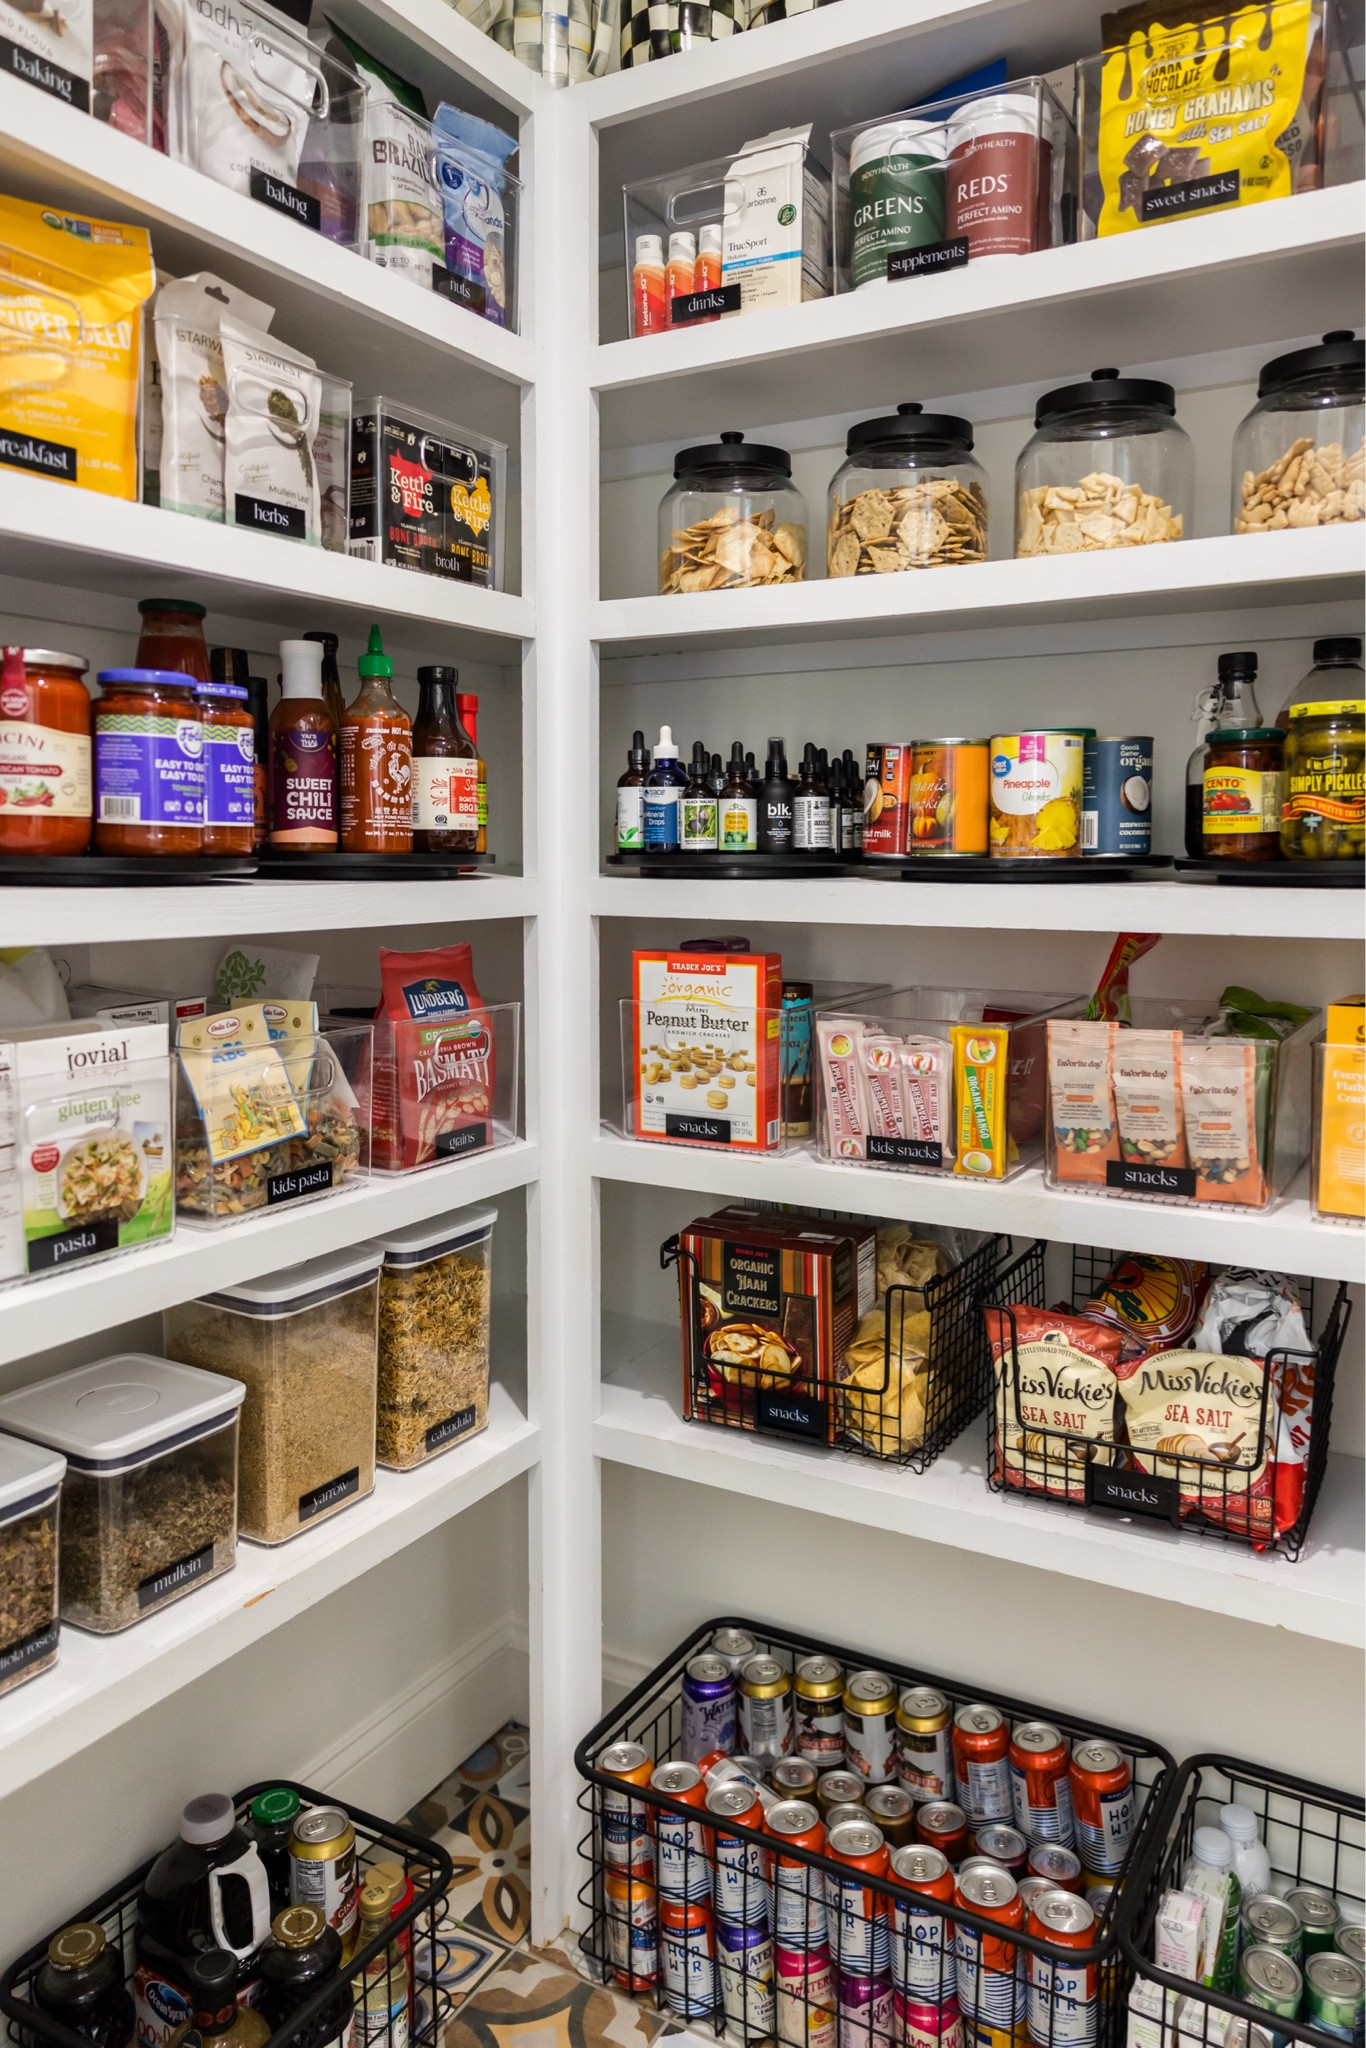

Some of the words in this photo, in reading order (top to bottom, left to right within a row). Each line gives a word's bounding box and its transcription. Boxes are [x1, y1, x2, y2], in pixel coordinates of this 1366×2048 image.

[12, 47, 72, 103] baking
[1125, 102, 1181, 138] HONEY
[1184, 78, 1275, 122] GRAHAMS
[1177, 121, 1207, 143] with
[1209, 125, 1233, 144] SEA
[1237, 113, 1270, 136] SALT
[957, 174, 1008, 203] REDS
[1145, 191, 1186, 212] sweet
[1188, 180, 1237, 201] snacks
[264, 178, 308, 220] baking
[747, 196, 777, 208] arbonne
[854, 195, 924, 228] GREENS
[956, 207, 990, 224] PERFECT
[990, 204, 1022, 215] AMINO
[881, 226, 911, 237] AMINO
[727, 238, 768, 252] TrueSport
[891, 245, 966, 272] supplements
[449, 278, 472, 299] nuts
[640, 278, 649, 326] Ketone-IQ
[687, 293, 725, 312] drinks
[0, 437, 69, 470] reakfast
[390, 466, 433, 496] Kettle
[268, 485, 297, 502] Mullein
[391, 487, 401, 504] &
[403, 491, 434, 514] Fire
[453, 486, 490, 515] Kettle
[253, 503, 290, 528] herbs
[453, 504, 463, 523] &
[464, 508, 490, 532] Fire
[389, 525, 410, 545] BONE
[435, 552, 460, 572] broth
[451, 543, 470, 558] BONE
[471, 549, 493, 567] BROTH
[391, 726, 402, 736] HOT
[155, 759, 181, 769] EASY
[184, 761, 195, 770] TO
[220, 764, 240, 773] EASY
[160, 770, 185, 781] EASY
[187, 771, 198, 781] TO
[225, 774, 245, 783] EASY
[286, 777, 333, 791] SWEET
[1003, 779, 1051, 790] Pineapple
[1207, 779, 1240, 789] CENTO
[1290, 774, 1323, 793] SIMPLY
[1325, 773, 1366, 792] PICKLES
[286, 791, 332, 807] CHILI
[649, 788, 666, 796] trace
[287, 808, 333, 821] SAUCE
[459, 803, 474, 812] BBQ
[767, 803, 792, 816] blk.
[873, 829, 892, 839] milk
[672, 962, 700, 971] TRADER
[701, 963, 724, 972] JOE'S
[667, 981, 734, 1000] organic
[409, 988, 465, 1016] LUNDBERG
[685, 1003, 709, 1014] MINI
[647, 1010, 698, 1030] Peanut
[700, 1014, 749, 1032] Butter
[699, 1031, 731, 1039] CRACKERS
[454, 1040, 477, 1051] BROWN
[67, 1040, 129, 1080] jovial
[1057, 1058, 1087, 1068] favorite
[1088, 1059, 1103, 1070] day
[890, 1076, 898, 1088] BAR
[1120, 1069, 1151, 1078] favorite
[1152, 1070, 1168, 1080] day
[968, 1075, 982, 1110] ORGANIC
[1063, 1082, 1095, 1090] monster
[1190, 1085, 1221, 1095] favorite
[1222, 1086, 1239, 1097] day
[1128, 1093, 1160, 1101] monster
[58, 1097, 108, 1123] gluten
[839, 1087, 862, 1136] STRAWBERRY
[963, 1104, 971, 1129] FRUIT
[1198, 1110, 1233, 1118] monster
[679, 1120, 718, 1136] snacks
[976, 1111, 990, 1140] MANGO
[448, 1131, 475, 1151] grains
[962, 1132, 970, 1145] BAR
[870, 1140, 895, 1156] kids
[897, 1144, 940, 1160] snacks
[271, 1174, 297, 1197] kids
[297, 1168, 330, 1193] pasta
[1124, 1169, 1179, 1187] snacks
[53, 1230, 96, 1261] pasta
[729, 1258, 774, 1275] ORGANIC
[726, 1293, 778, 1312] CRACKERS
[1039, 1365, 1114, 1409] Vickie's
[1139, 1369, 1192, 1396] Miss
[1184, 1361, 1264, 1408] Vickie's
[769, 1406, 810, 1424] snacks
[1021, 1406, 1049, 1425] SEA
[1053, 1410, 1088, 1431] SALT
[1164, 1404, 1189, 1423] SEA
[1196, 1407, 1233, 1428] SALT
[431, 1412, 473, 1443] calendula
[311, 1478, 349, 1513] yarrow
[1107, 1483, 1159, 1505] snacks
[154, 1556, 202, 1593] mullein
[826, 1739, 844, 1749] BEER
[607, 1832, 626, 1842] WATER
[659, 1830, 694, 1847] HOP
[661, 1846, 697, 1861] WTR
[901, 1924, 939, 1942] HOP
[1038, 1969, 1077, 1994] HOP
[148, 1989, 168, 2016] Ocean
[167, 2004, 188, 2022] Spray
